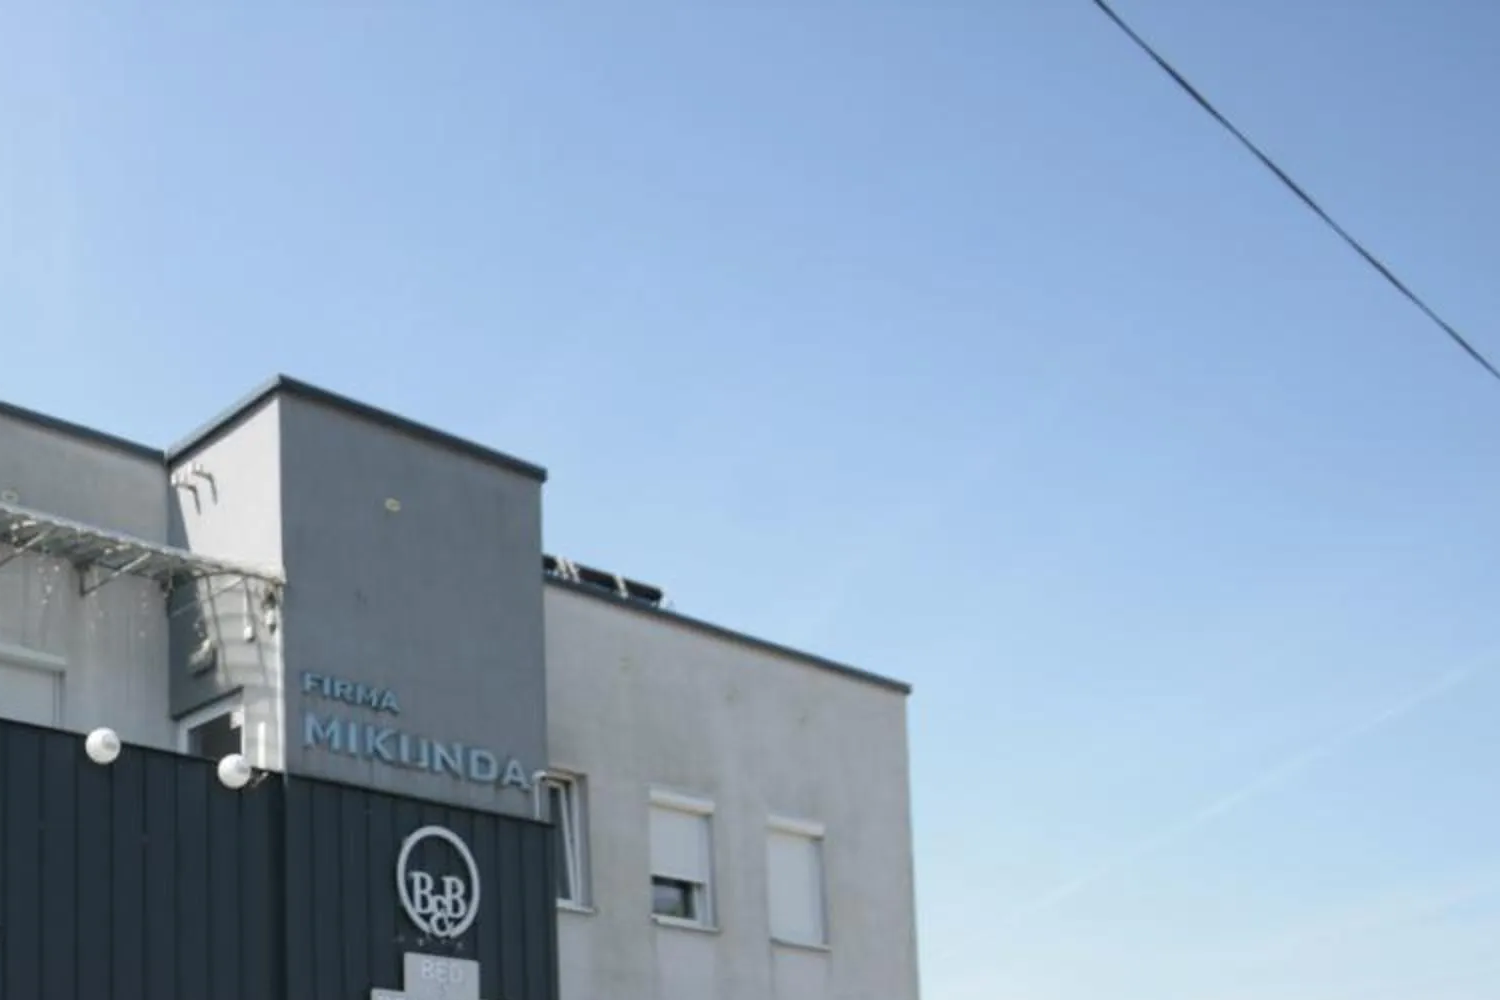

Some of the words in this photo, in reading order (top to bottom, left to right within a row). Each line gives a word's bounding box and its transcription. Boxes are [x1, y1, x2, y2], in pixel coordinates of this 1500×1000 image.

[301, 671, 401, 715] FIRMA
[302, 710, 533, 792] MIKUNDA
[421, 958, 464, 983] BED
